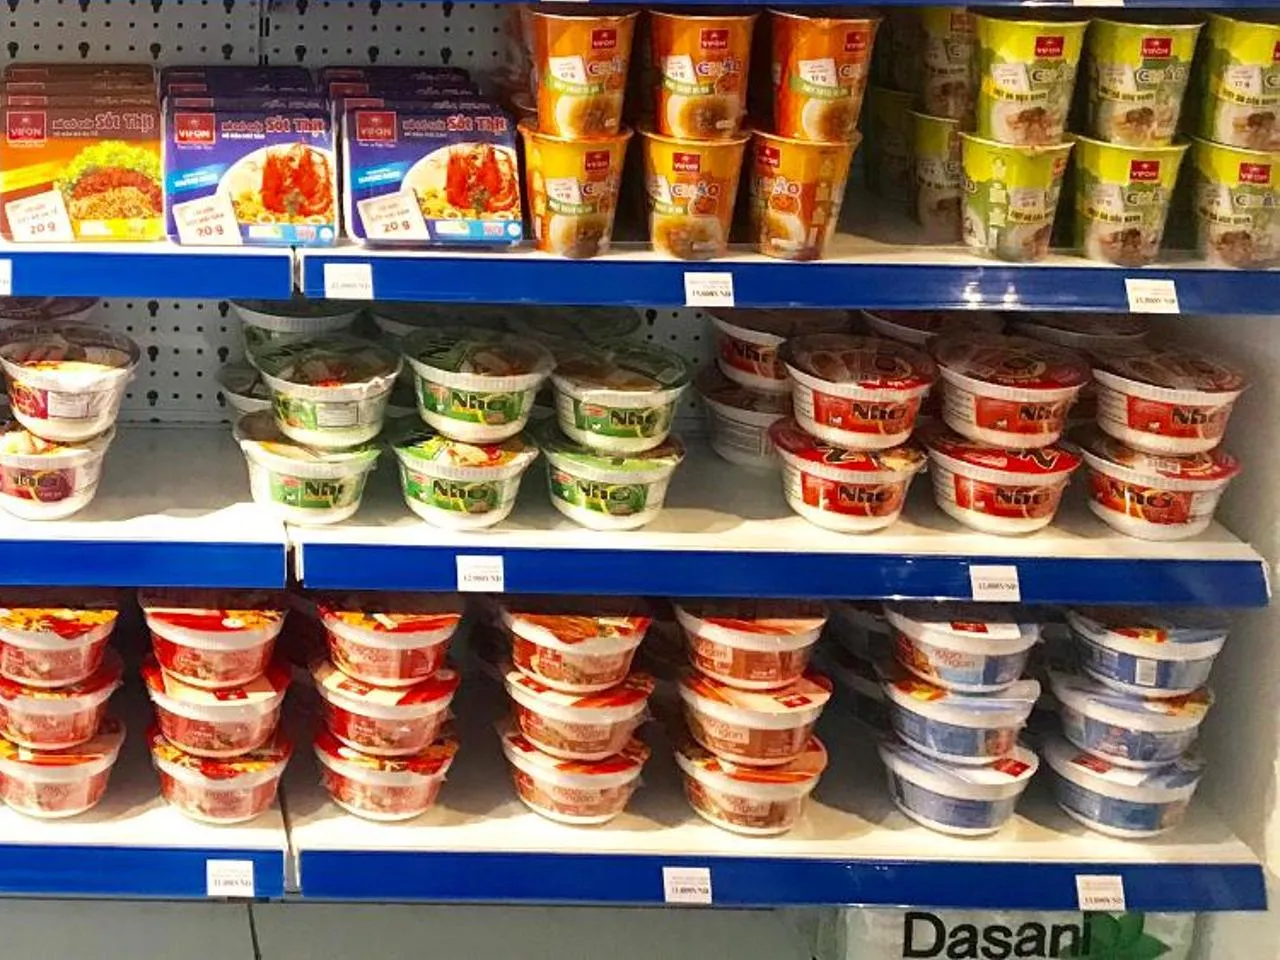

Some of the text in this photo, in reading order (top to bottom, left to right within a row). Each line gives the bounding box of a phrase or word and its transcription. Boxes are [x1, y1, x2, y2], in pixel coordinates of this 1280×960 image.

[10, 127, 43, 138] VIFON
[179, 129, 211, 139] VIFON
[361, 127, 393, 137] VIFON
[902, 911, 1092, 959] Dasani
